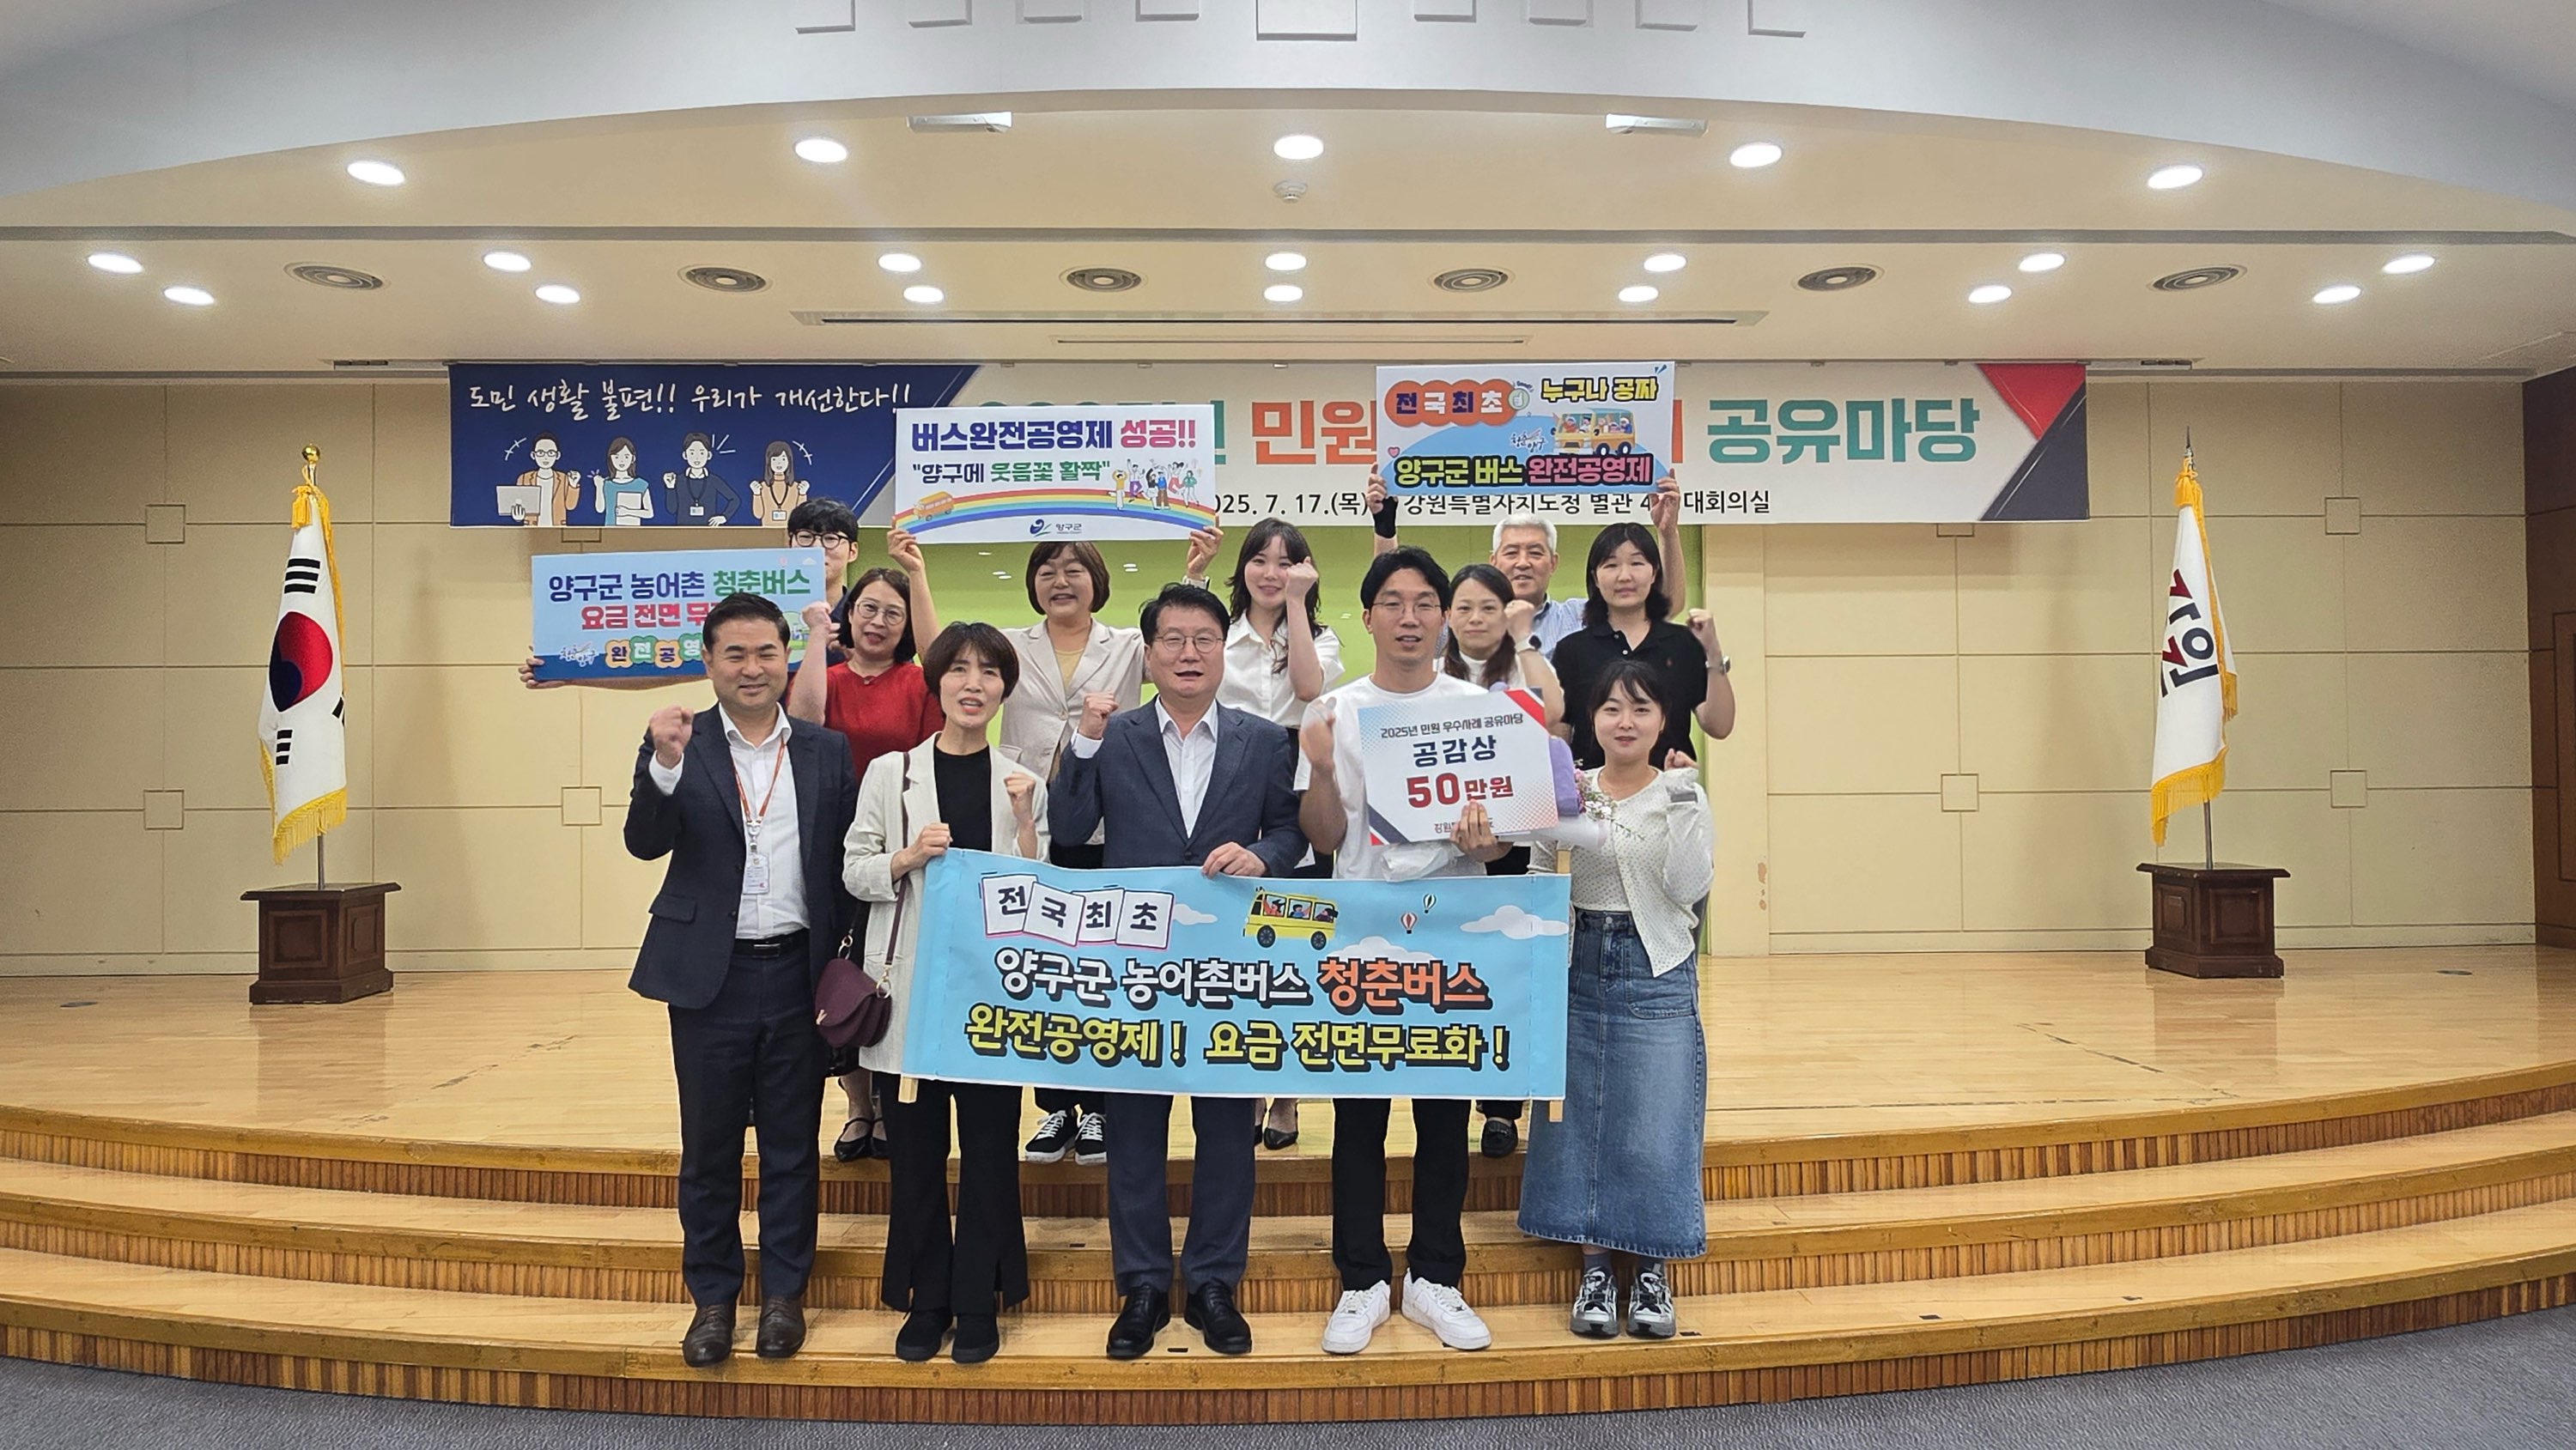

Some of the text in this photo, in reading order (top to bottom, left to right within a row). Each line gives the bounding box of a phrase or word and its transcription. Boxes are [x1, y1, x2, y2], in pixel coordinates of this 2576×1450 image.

[470, 379, 910, 422] 도민 생활 불편!! 우리가 개선한다!!
[1396, 391, 1504, 415] 전국최초
[1541, 377, 1658, 403] 누구나 공짜
[912, 420, 1113, 452] 버스완전공영제
[1121, 419, 1196, 448] 성공!!
[1707, 397, 1980, 464] 공유마당
[913, 460, 1110, 484] "양구에 웃음꽃 활짝"
[1394, 453, 1655, 487] 양구군 버스 완전공영제
[1266, 494, 1285, 515] 7.
[1590, 494, 1632, 514] 별관
[1683, 490, 1771, 514] 대회의실
[549, 569, 811, 602] 양구군 농어촌 청춘버스
[581, 604, 629, 630] 요금
[634, 603, 681, 628] 전면
[611, 639, 702, 662] 완전공영
[1381, 713, 1524, 738] 2025년 민원 우수사례 공유마당
[1413, 735, 1497, 768] 공감상
[1406, 772, 1514, 808] 50만원
[998, 885, 1157, 931] 전국최초
[995, 947, 1490, 1010] 양구군 농어촌버스 청춘버스
[1205, 1022, 1285, 1066] 요금
